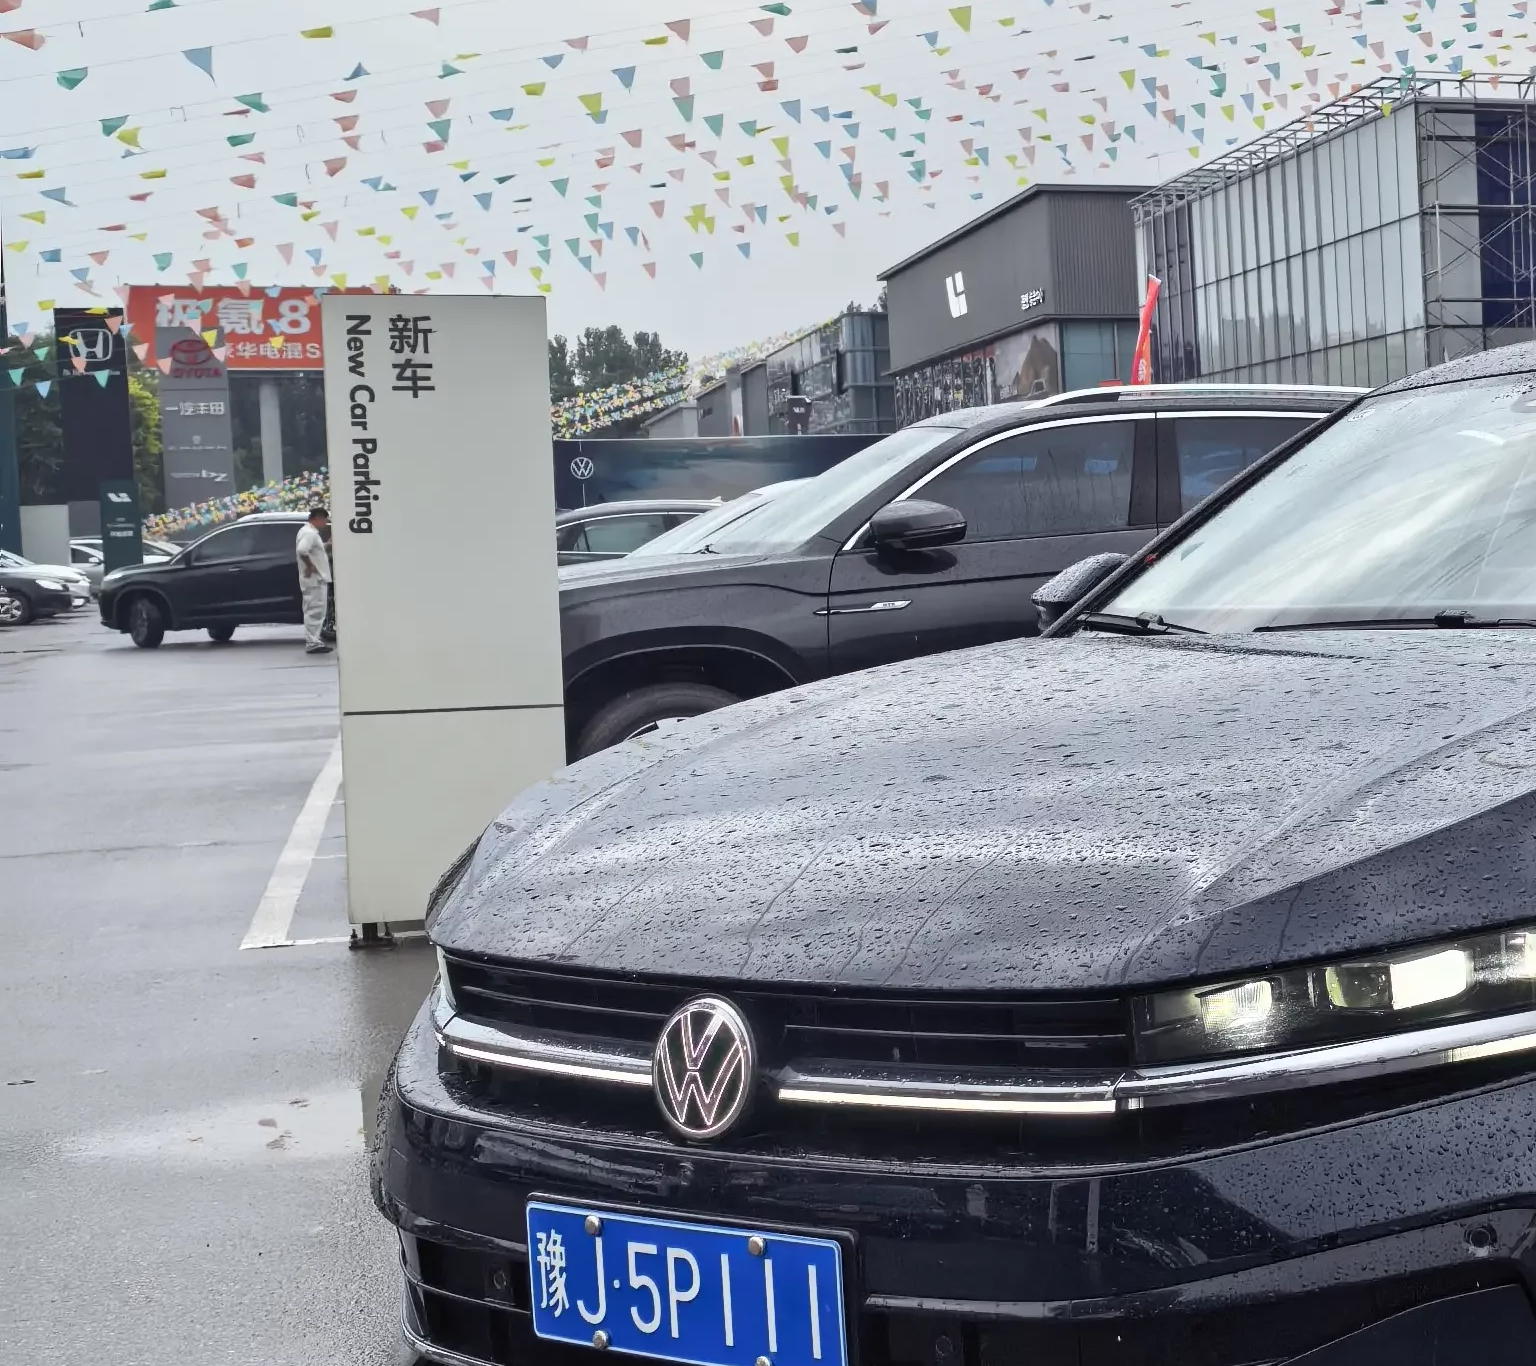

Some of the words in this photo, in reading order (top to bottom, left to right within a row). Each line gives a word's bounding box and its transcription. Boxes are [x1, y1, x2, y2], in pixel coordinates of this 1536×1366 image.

[345, 314, 372, 377] New
[388, 313, 438, 399] 新车
[349, 384, 376, 431] Car
[348, 438, 382, 534] Parking
